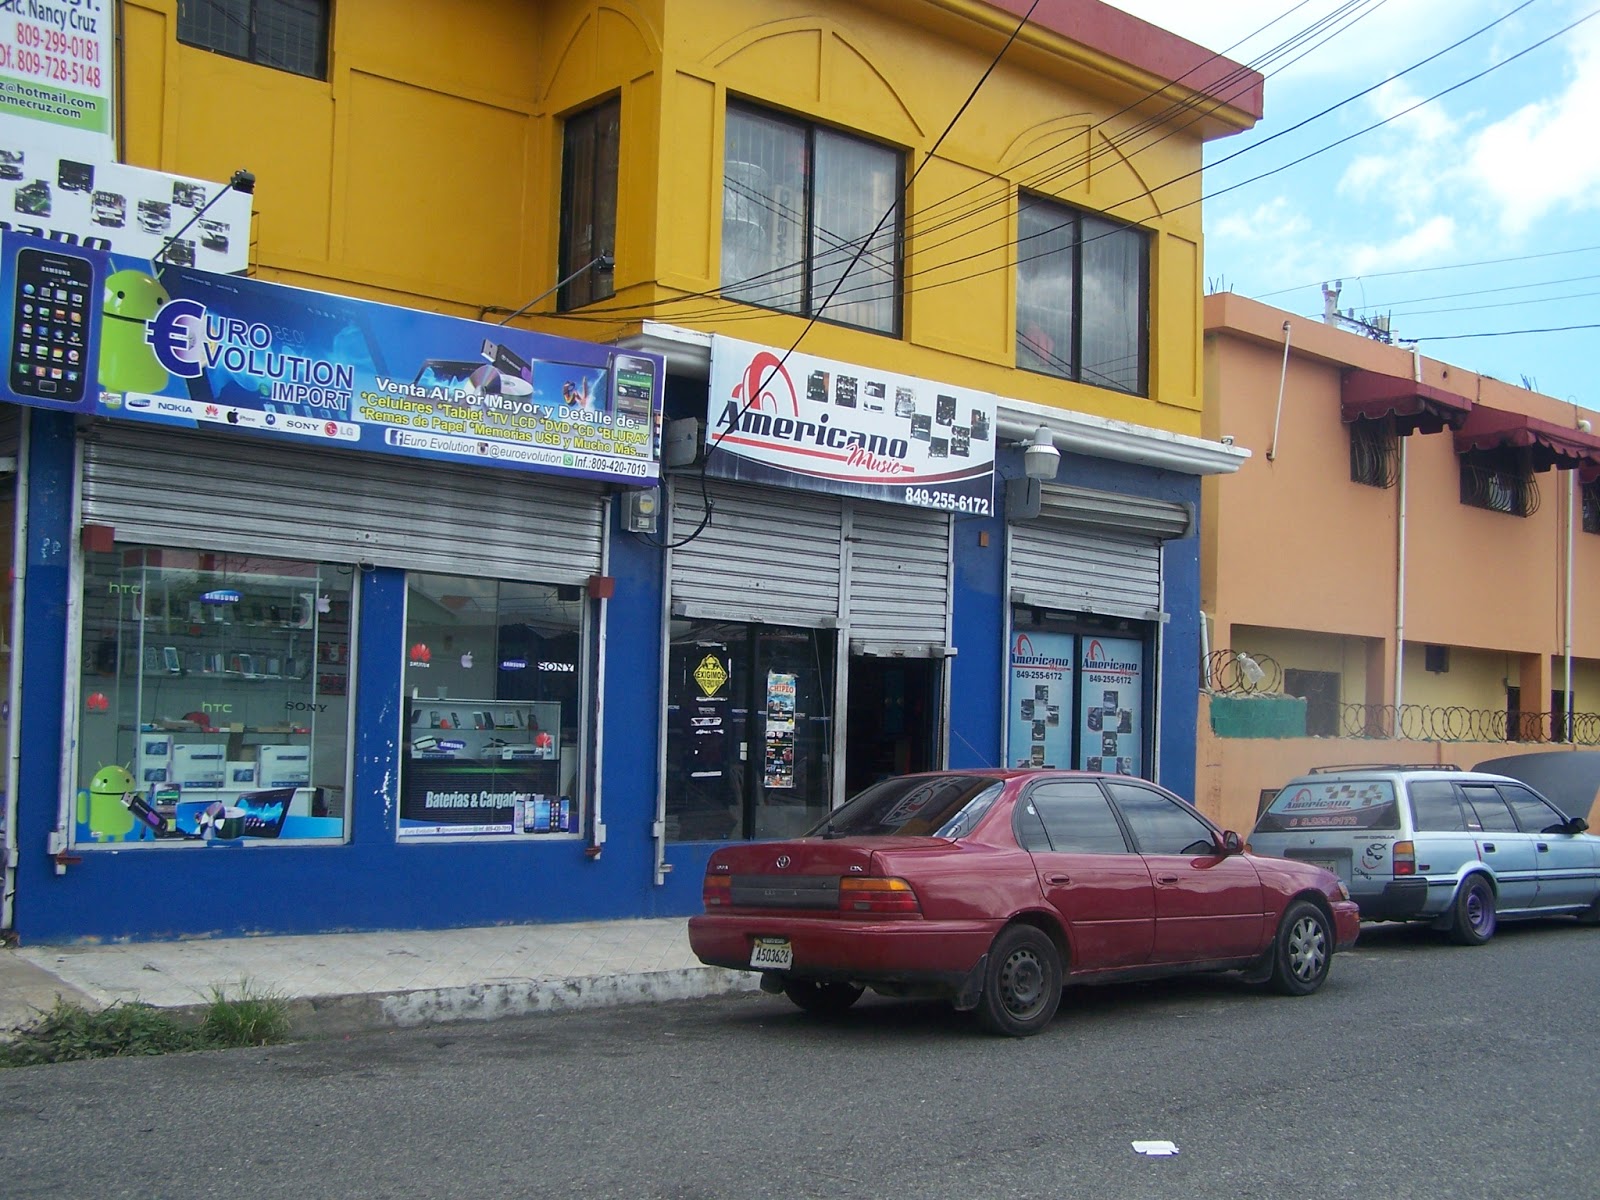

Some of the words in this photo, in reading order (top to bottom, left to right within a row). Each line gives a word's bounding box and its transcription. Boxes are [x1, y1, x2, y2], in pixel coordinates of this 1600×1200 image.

[29, 0, 67, 32] Nancy
[70, 8, 97, 34] Cruz
[17, 22, 99, 63] 809-299-0181
[17, 49, 101, 89] 809-728-5148
[41, 265, 71, 277] SAMSUNG
[271, 381, 352, 411] IMPORT
[375, 377, 426, 399] Venta
[453, 389, 485, 406] Por
[488, 394, 540, 415] Mayor
[544, 404, 554, 419] y
[558, 405, 612, 426] Detalle
[616, 413, 640, 429] de:
[157, 402, 193, 414] NOKIA
[286, 420, 319, 432] SONY
[511, 413, 537, 429] LCD
[340, 426, 354, 437] LG
[413, 415, 429, 428] de
[431, 418, 467, 434] Papel
[535, 431, 561, 445] USB
[563, 437, 571, 449] y
[574, 438, 611, 453] Mucho
[716, 400, 908, 460] Americano
[403, 434, 427, 447] Euro
[430, 437, 475, 454] Evolution
[490, 446, 562, 464] @euroevolution
[845, 443, 903, 474] Music
[905, 487, 989, 515] 849-255-6172
[204, 592, 240, 603] SAMSUNG
[537, 661, 575, 672] SONY
[1012, 653, 1069, 667] Americano
[1082, 658, 1138, 671] Americano
[696, 671, 727, 680] EXIGIMOS
[1016, 671, 1062, 680] 849-255-6172
[1089, 675, 1132, 684] 849-255-6172
[285, 701, 328, 713] SONY
[425, 791, 468, 809] Baterias
[470, 791, 478, 808] &
